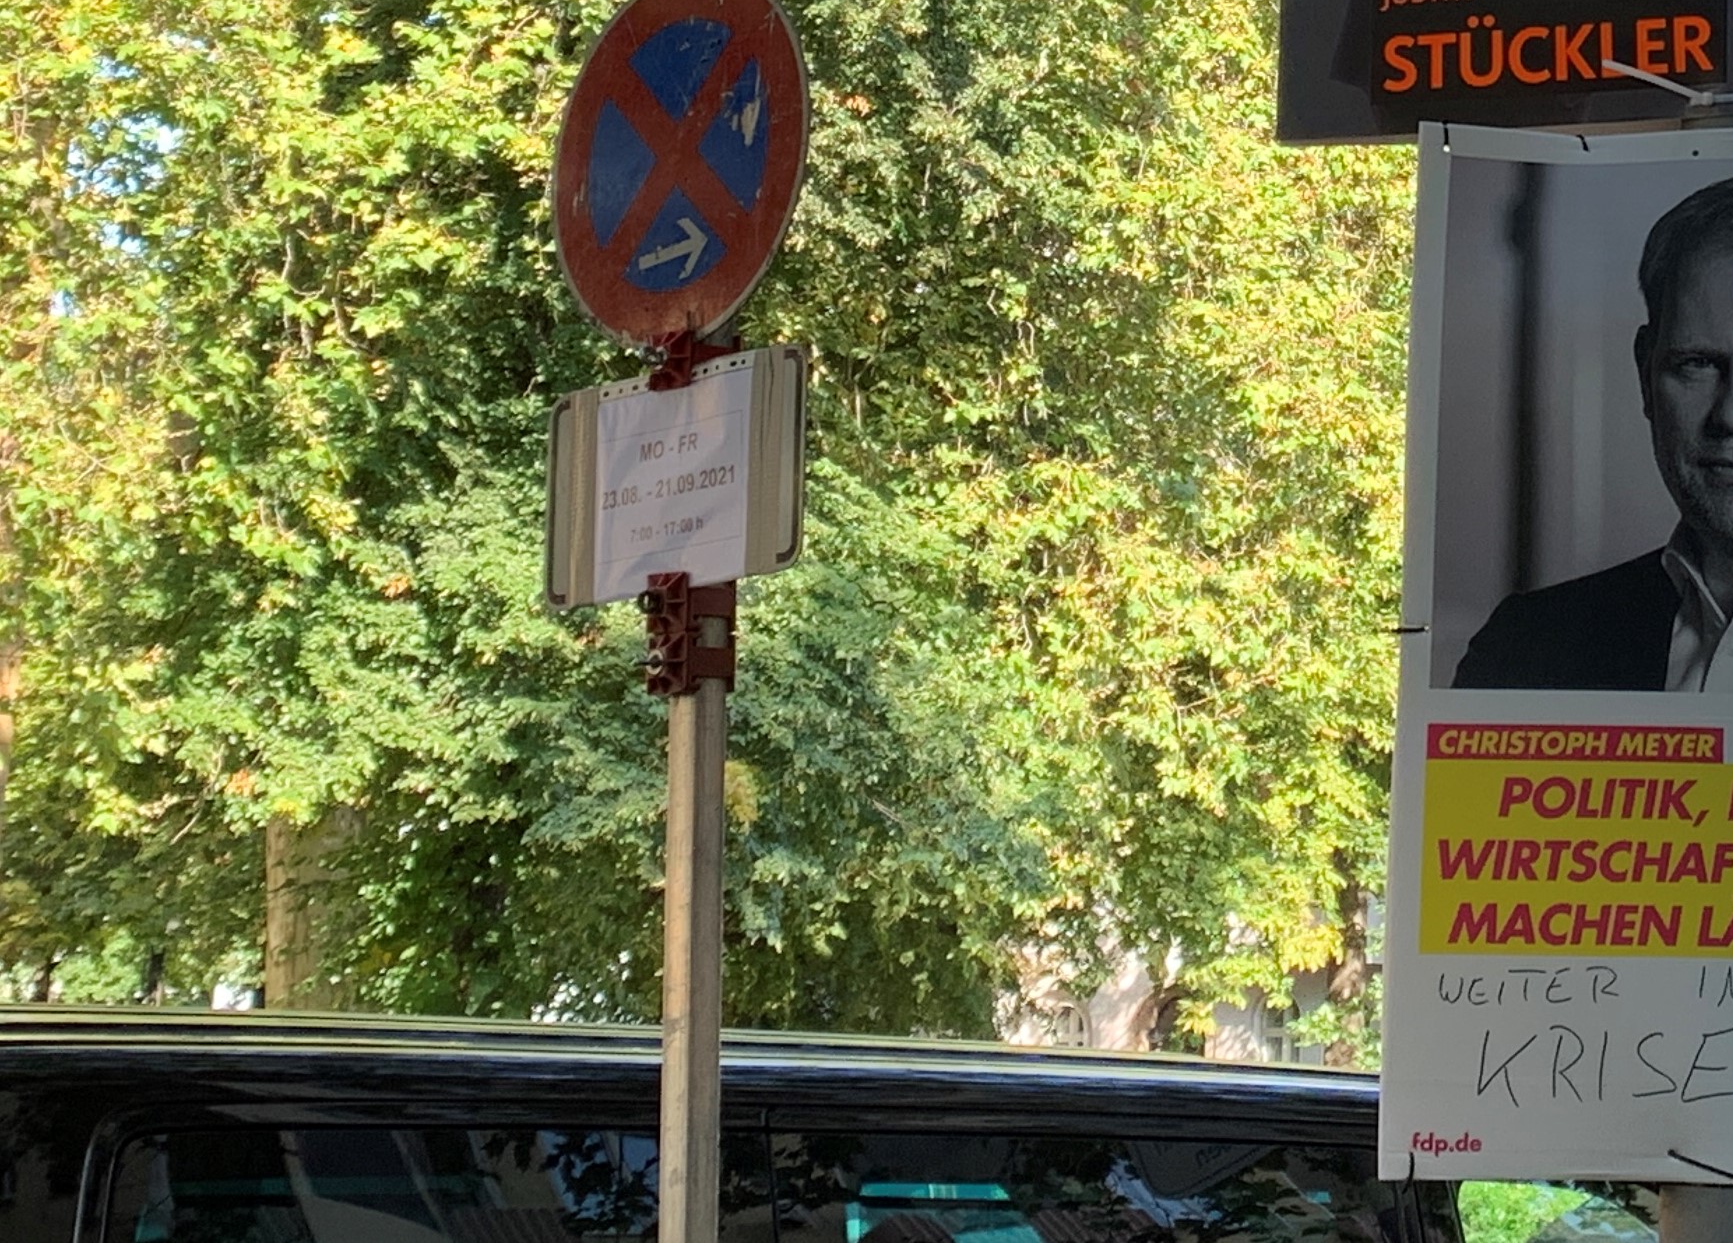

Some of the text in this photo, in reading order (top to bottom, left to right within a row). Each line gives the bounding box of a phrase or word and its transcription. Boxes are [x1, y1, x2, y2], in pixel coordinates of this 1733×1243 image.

[1382, 13, 1715, 92] STÜCKLER
[639, 440, 665, 462] MO
[678, 432, 698, 454] FR
[602, 485, 642, 511] 23.08.
[655, 464, 735, 499] 21.09.2021
[1438, 731, 1717, 758] CHRISTOPH MEYER
[1498, 777, 1710, 828] POLITIK,
[1448, 902, 1685, 946] MACHEN
[1438, 966, 1620, 1006] WEITER
[1411, 1132, 1482, 1157] fdp.de
